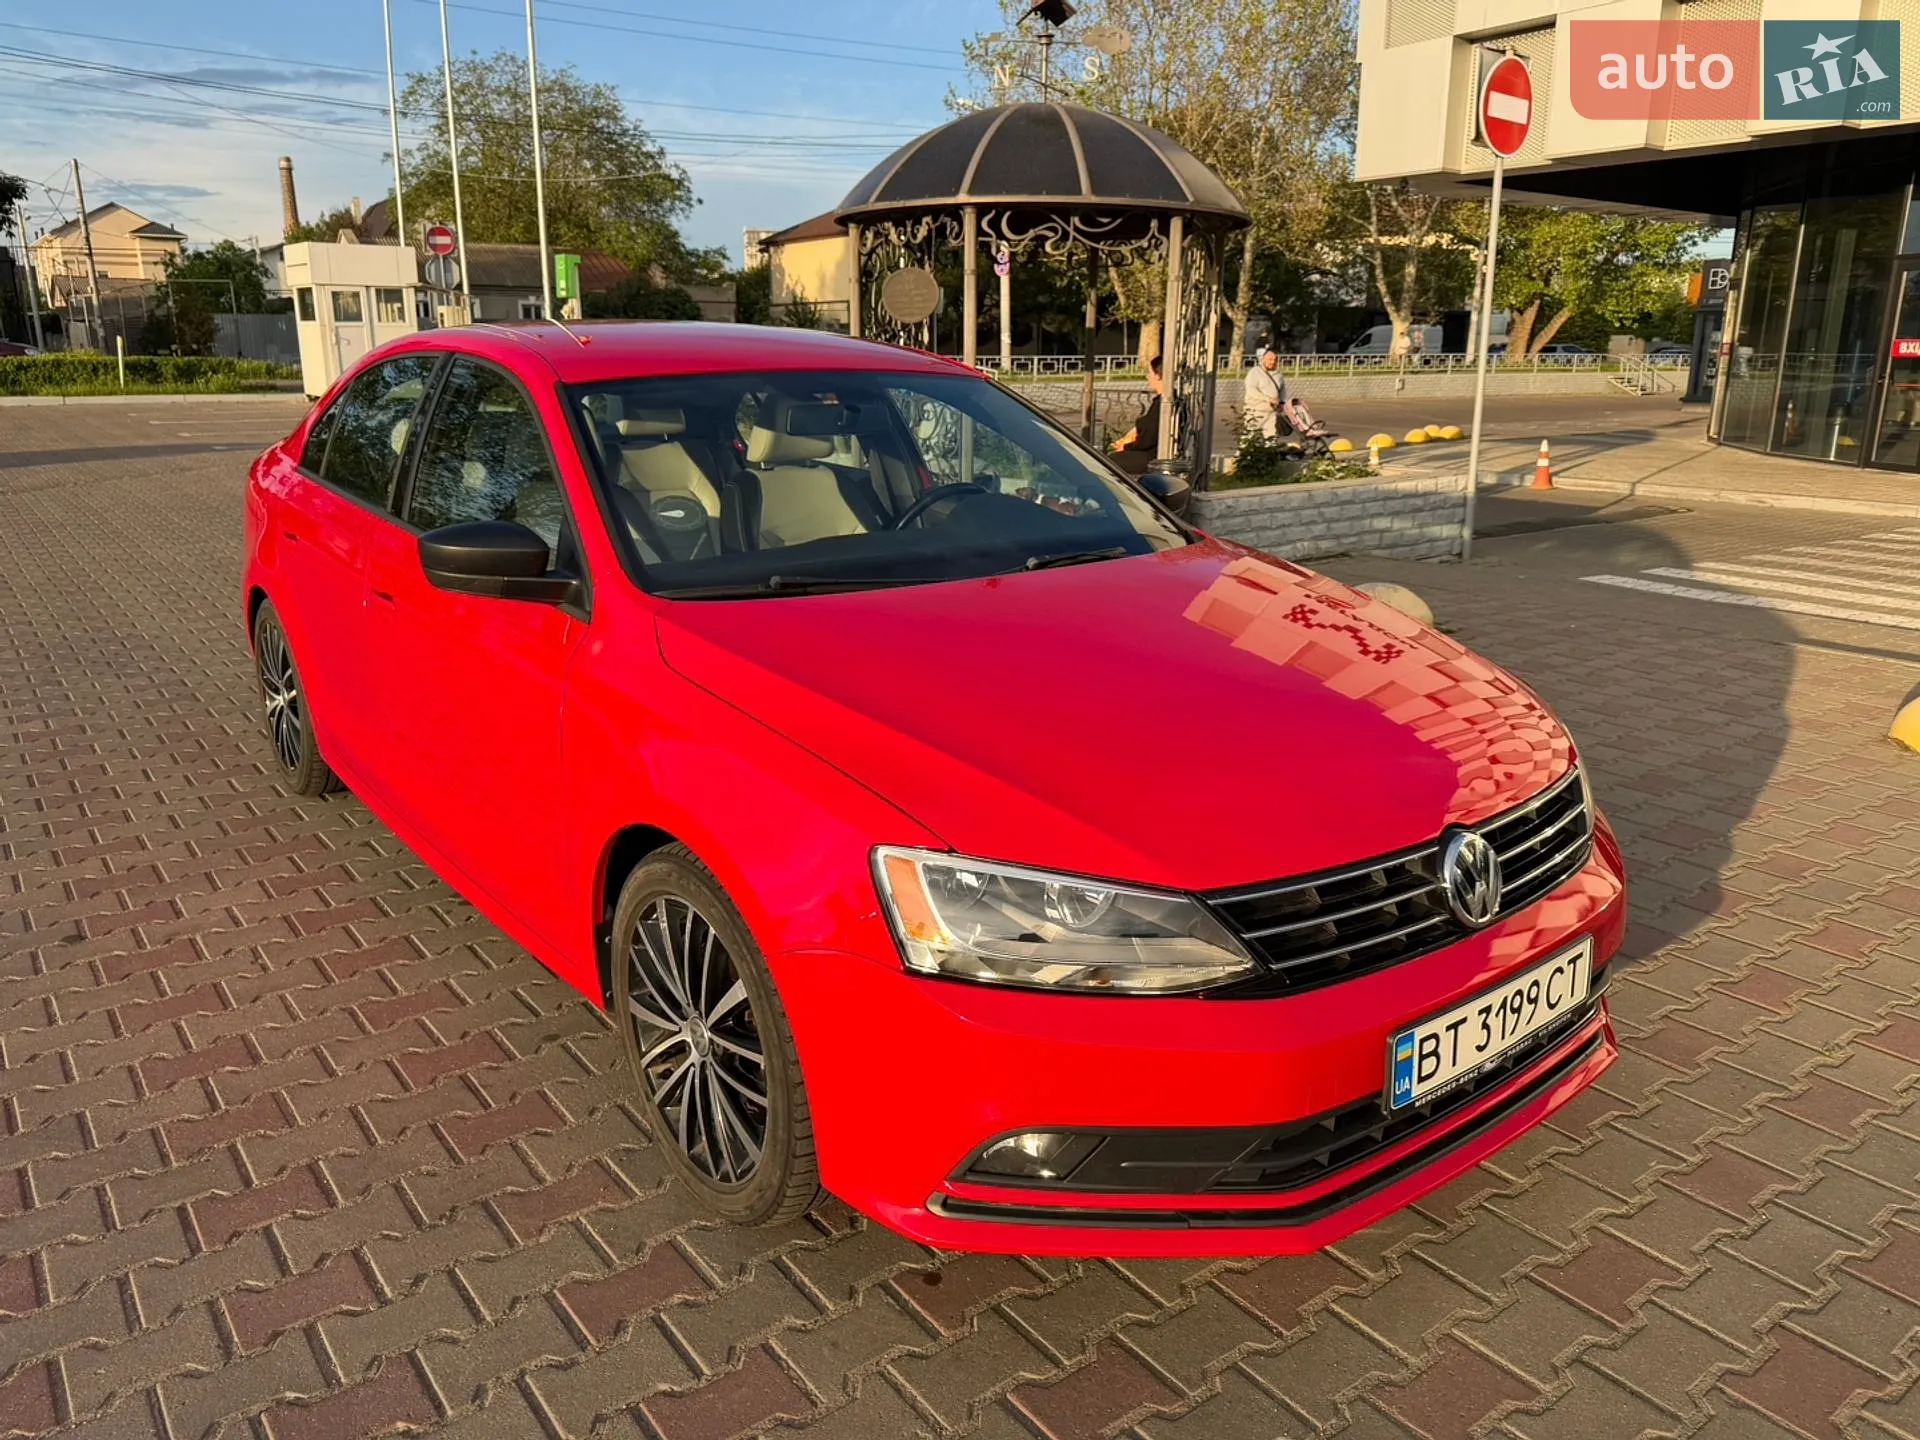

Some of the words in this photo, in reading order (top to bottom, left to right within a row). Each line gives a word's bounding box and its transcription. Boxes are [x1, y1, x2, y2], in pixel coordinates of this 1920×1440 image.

[1416, 1015, 1467, 1085] BT
[1475, 979, 1540, 1053] 3199
[1545, 951, 1584, 1011] CT
[1395, 1076, 1411, 1095] UA
